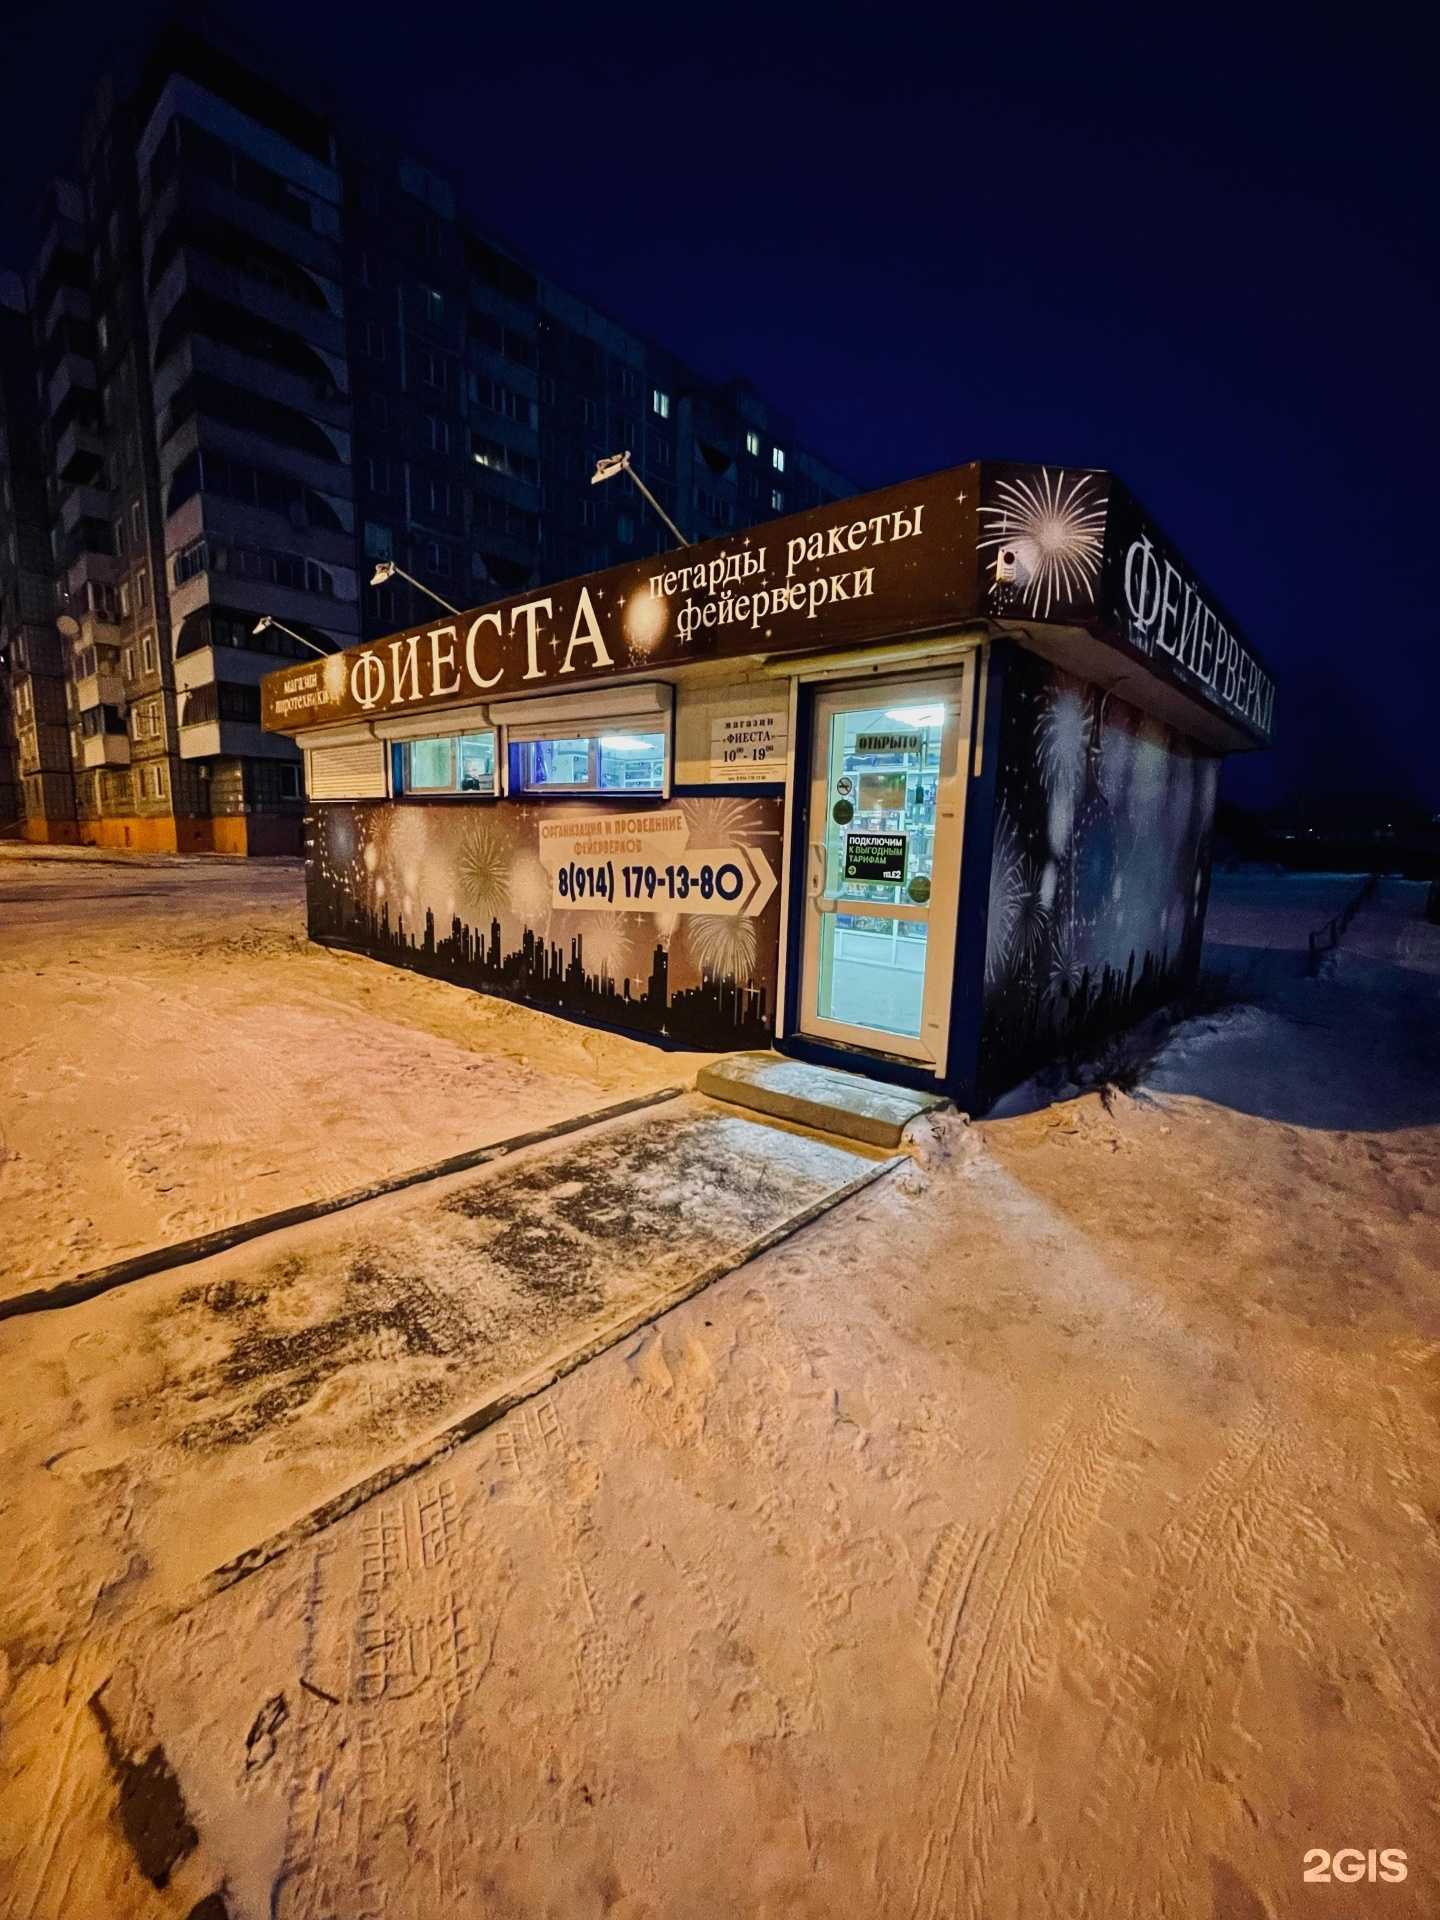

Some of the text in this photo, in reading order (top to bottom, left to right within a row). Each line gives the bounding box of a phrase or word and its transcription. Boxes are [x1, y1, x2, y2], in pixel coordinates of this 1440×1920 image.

[649, 504, 925, 600] петарды ракеты
[677, 566, 876, 642] фейерверки
[1124, 532, 1276, 735] ФЕЙЕРВЕРКИ
[350, 586, 615, 709] ФИЕСТА
[283, 672, 318, 694] магазин
[724, 718, 774, 729] магазин
[858, 734, 918, 750] ОТКРЫТО
[848, 846, 903, 856] К ВЫГОДНЫМ
[849, 836, 903, 847] ПОДКЛЮЧИМ
[848, 855, 887, 864] ТАРИФАМ
[558, 861, 744, 903] 8(914) 179-13-80
